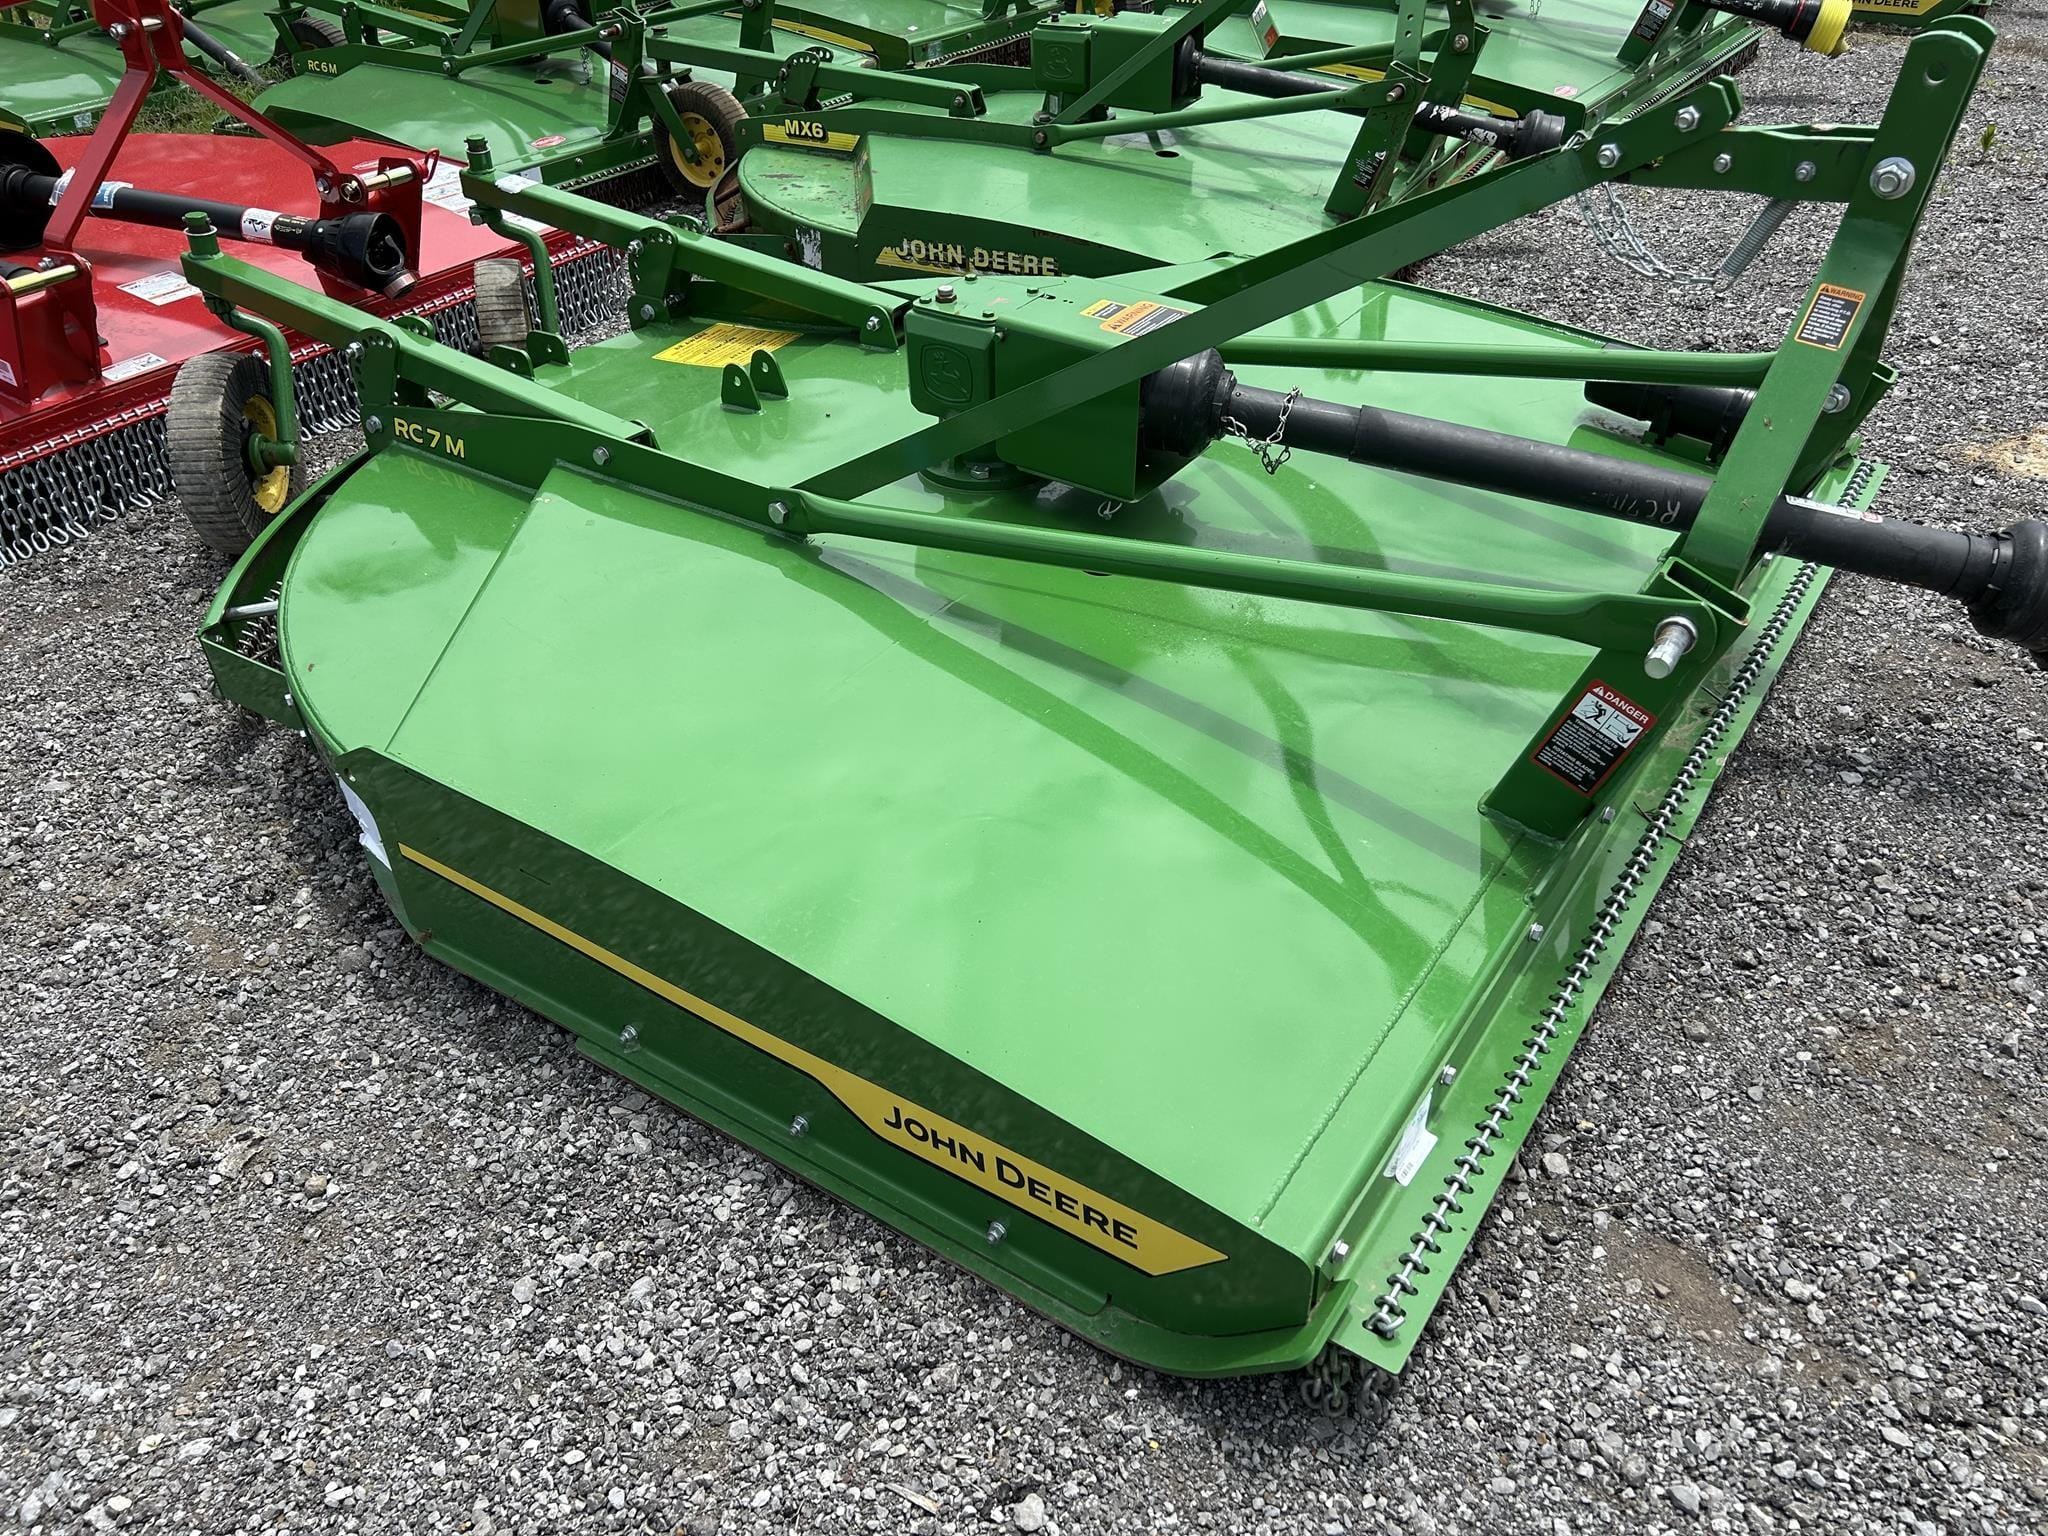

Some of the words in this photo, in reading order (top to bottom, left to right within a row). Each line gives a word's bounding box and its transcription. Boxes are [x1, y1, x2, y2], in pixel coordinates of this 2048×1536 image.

[308, 59, 337, 74] RC6M
[785, 119, 823, 138] MX6
[896, 238, 962, 265] JOHN
[974, 246, 1057, 276] DEERE
[1830, 287, 1863, 301] WARNING
[394, 417, 465, 459] RC7M
[1604, 691, 1649, 723] DANGER
[884, 1106, 985, 1173] JOHN
[995, 1156, 1138, 1250] DEERE
